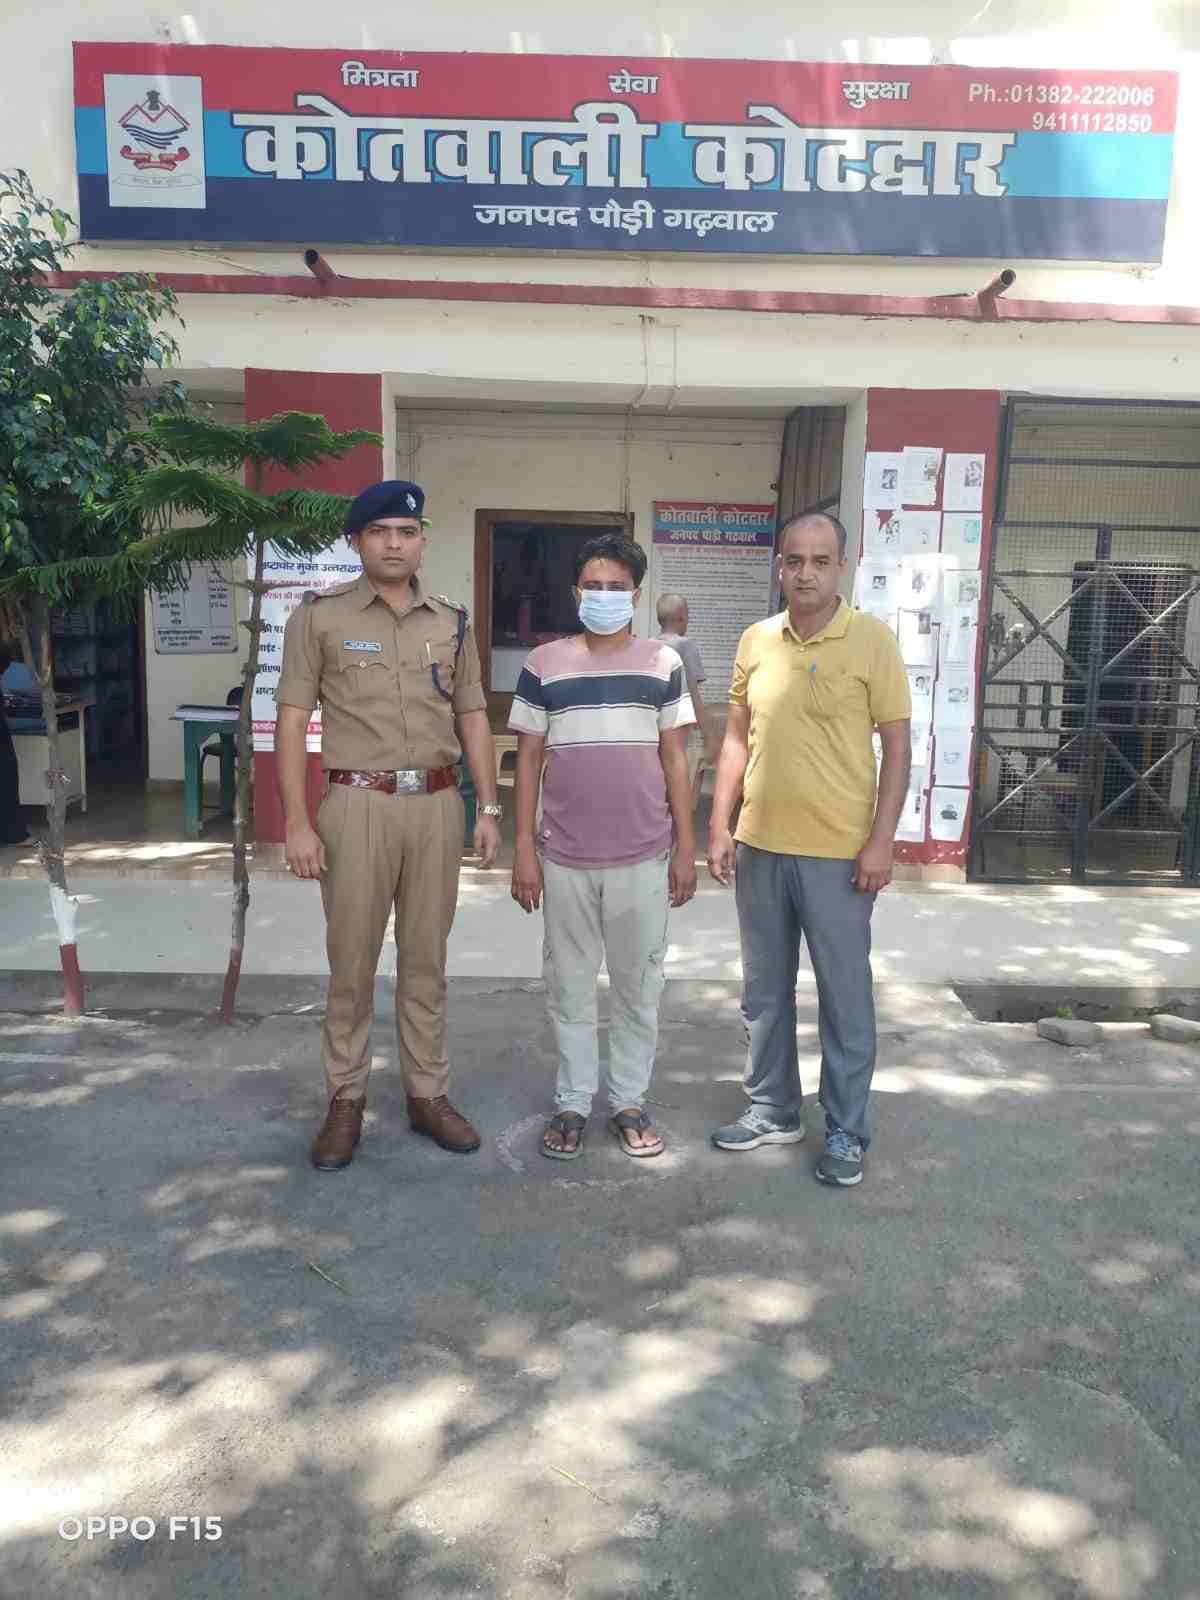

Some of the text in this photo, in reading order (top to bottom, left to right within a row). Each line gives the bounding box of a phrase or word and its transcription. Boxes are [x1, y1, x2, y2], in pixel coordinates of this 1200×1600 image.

[340, 61, 912, 109] मित्रता सेवा सुरक्षा
[1032, 111, 1153, 133] 9411112850
[232, 95, 1016, 197] कोतवाली कोटद्वार
[473, 204, 581, 227] जनपद
[663, 208, 778, 237] गढ़वाल
